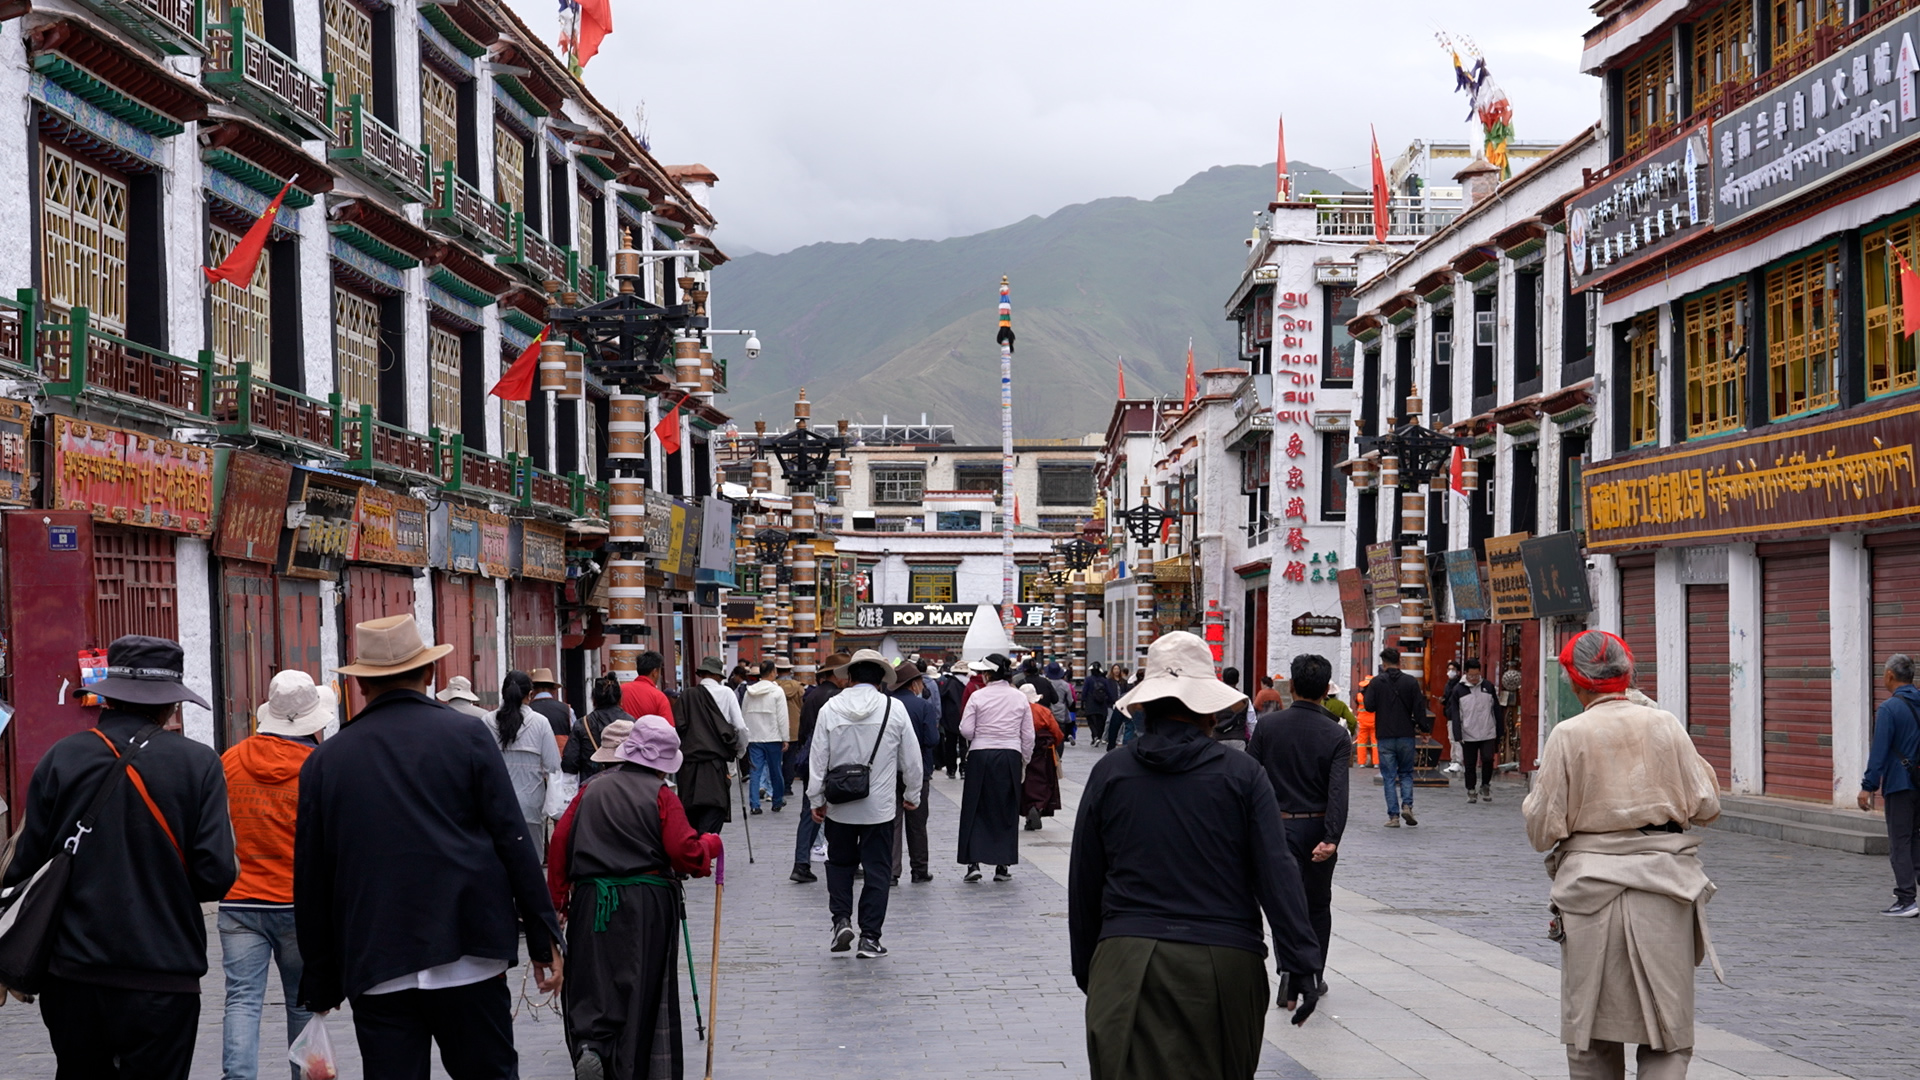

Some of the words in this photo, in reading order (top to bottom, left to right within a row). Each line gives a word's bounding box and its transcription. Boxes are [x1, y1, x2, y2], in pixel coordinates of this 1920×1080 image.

[1282, 432, 1309, 582] 象泉藏餐馆
[858, 605, 883, 628] 必胜客
[893, 611, 925, 626] POP
[929, 611, 973, 626] MART
